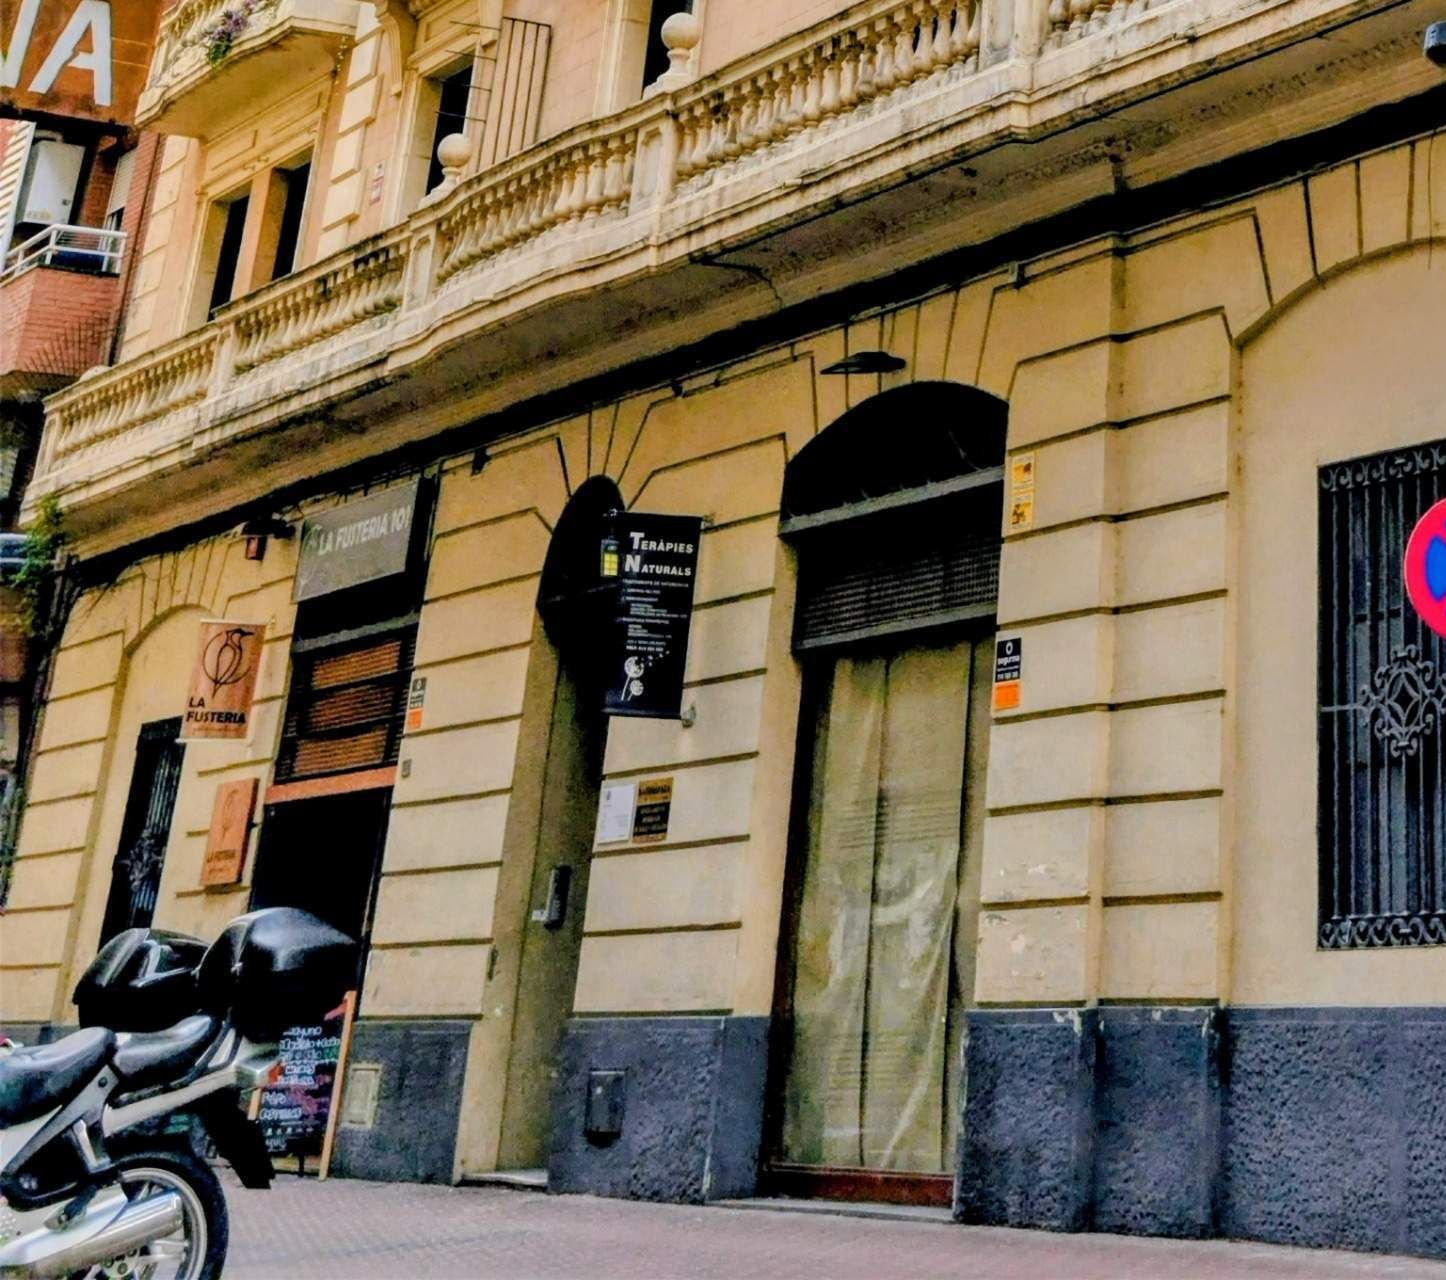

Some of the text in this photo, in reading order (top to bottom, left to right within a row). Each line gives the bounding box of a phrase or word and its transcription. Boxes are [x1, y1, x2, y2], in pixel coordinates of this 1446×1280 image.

[335, 513, 388, 551] FUSTERIA
[624, 554, 692, 576] NATURALS
[188, 697, 205, 708] LA
[186, 711, 247, 724] FUSTERIA
